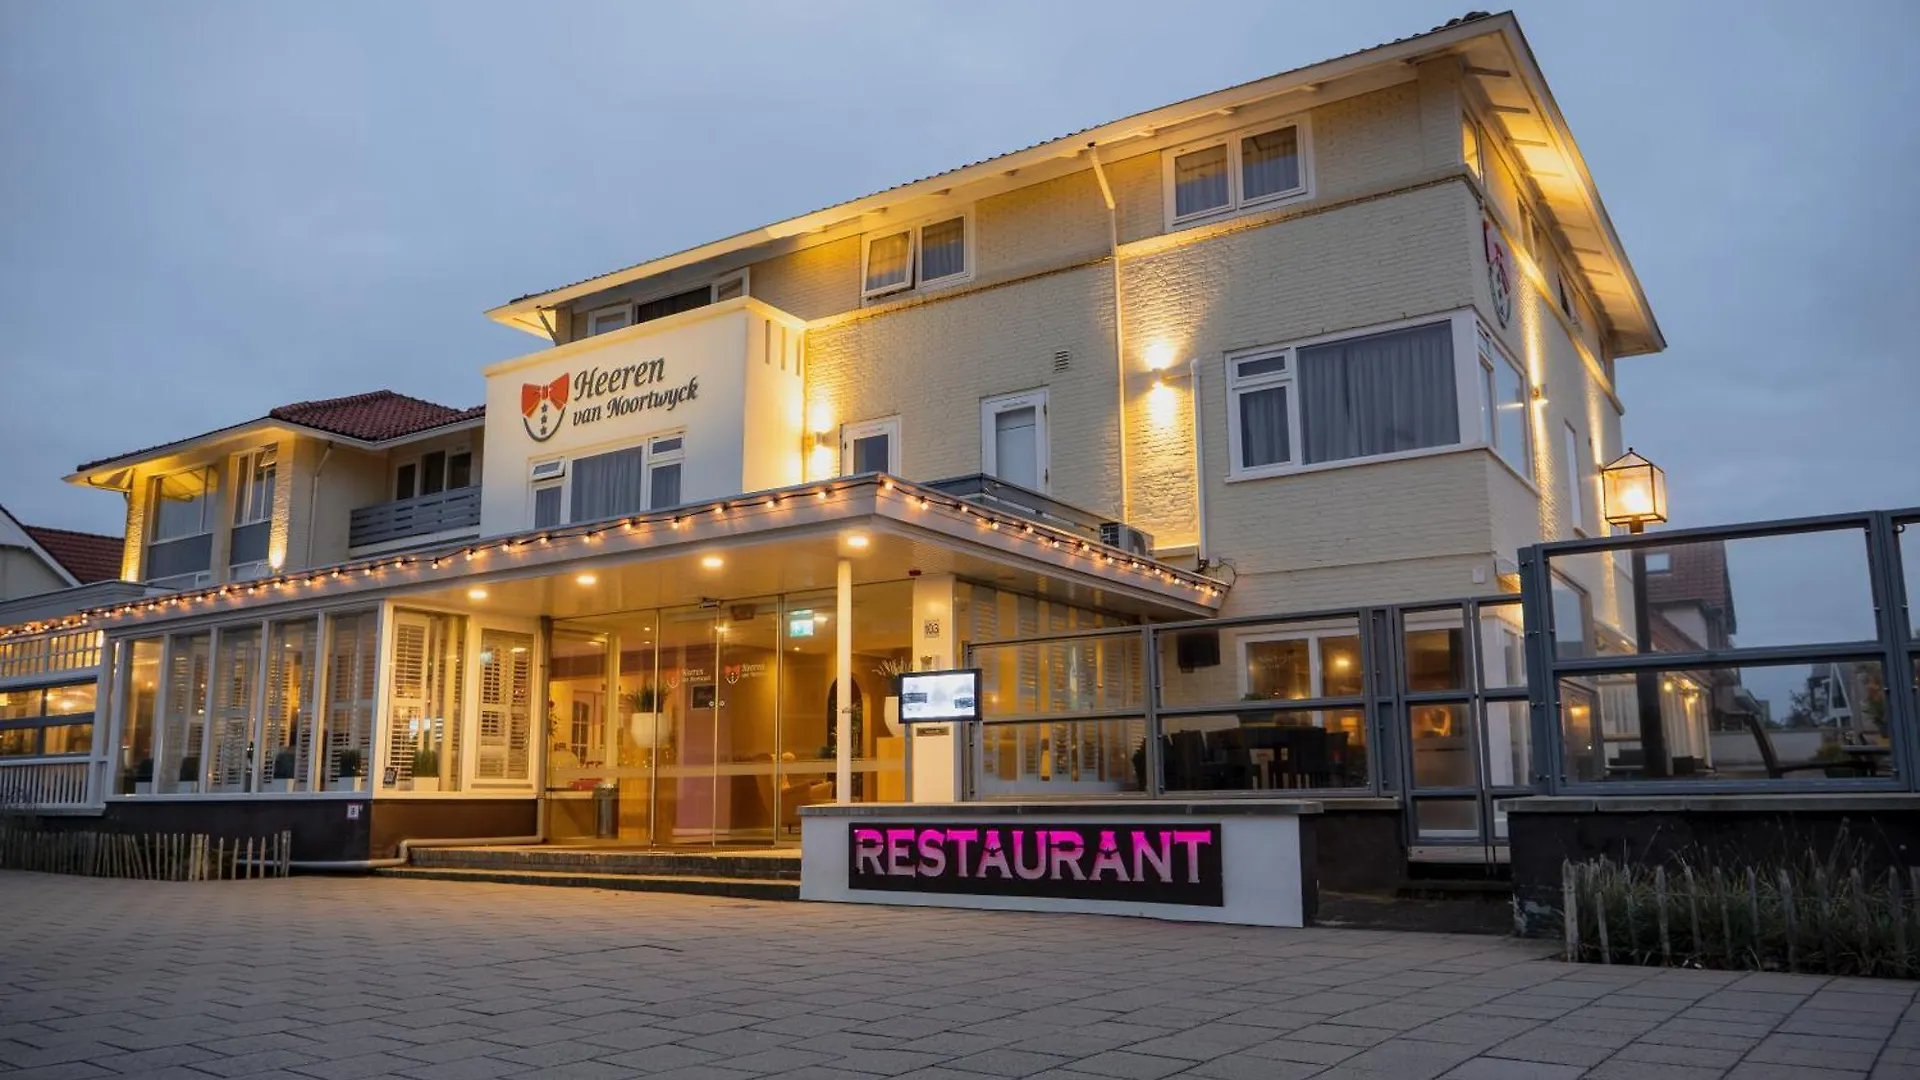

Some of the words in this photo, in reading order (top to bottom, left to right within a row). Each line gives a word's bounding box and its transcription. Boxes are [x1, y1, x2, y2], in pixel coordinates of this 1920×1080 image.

[573, 405, 602, 426] van
[607, 376, 698, 418] Noortwyck
[574, 357, 664, 401] Heeren
[855, 829, 1211, 883] RESTAURANT
